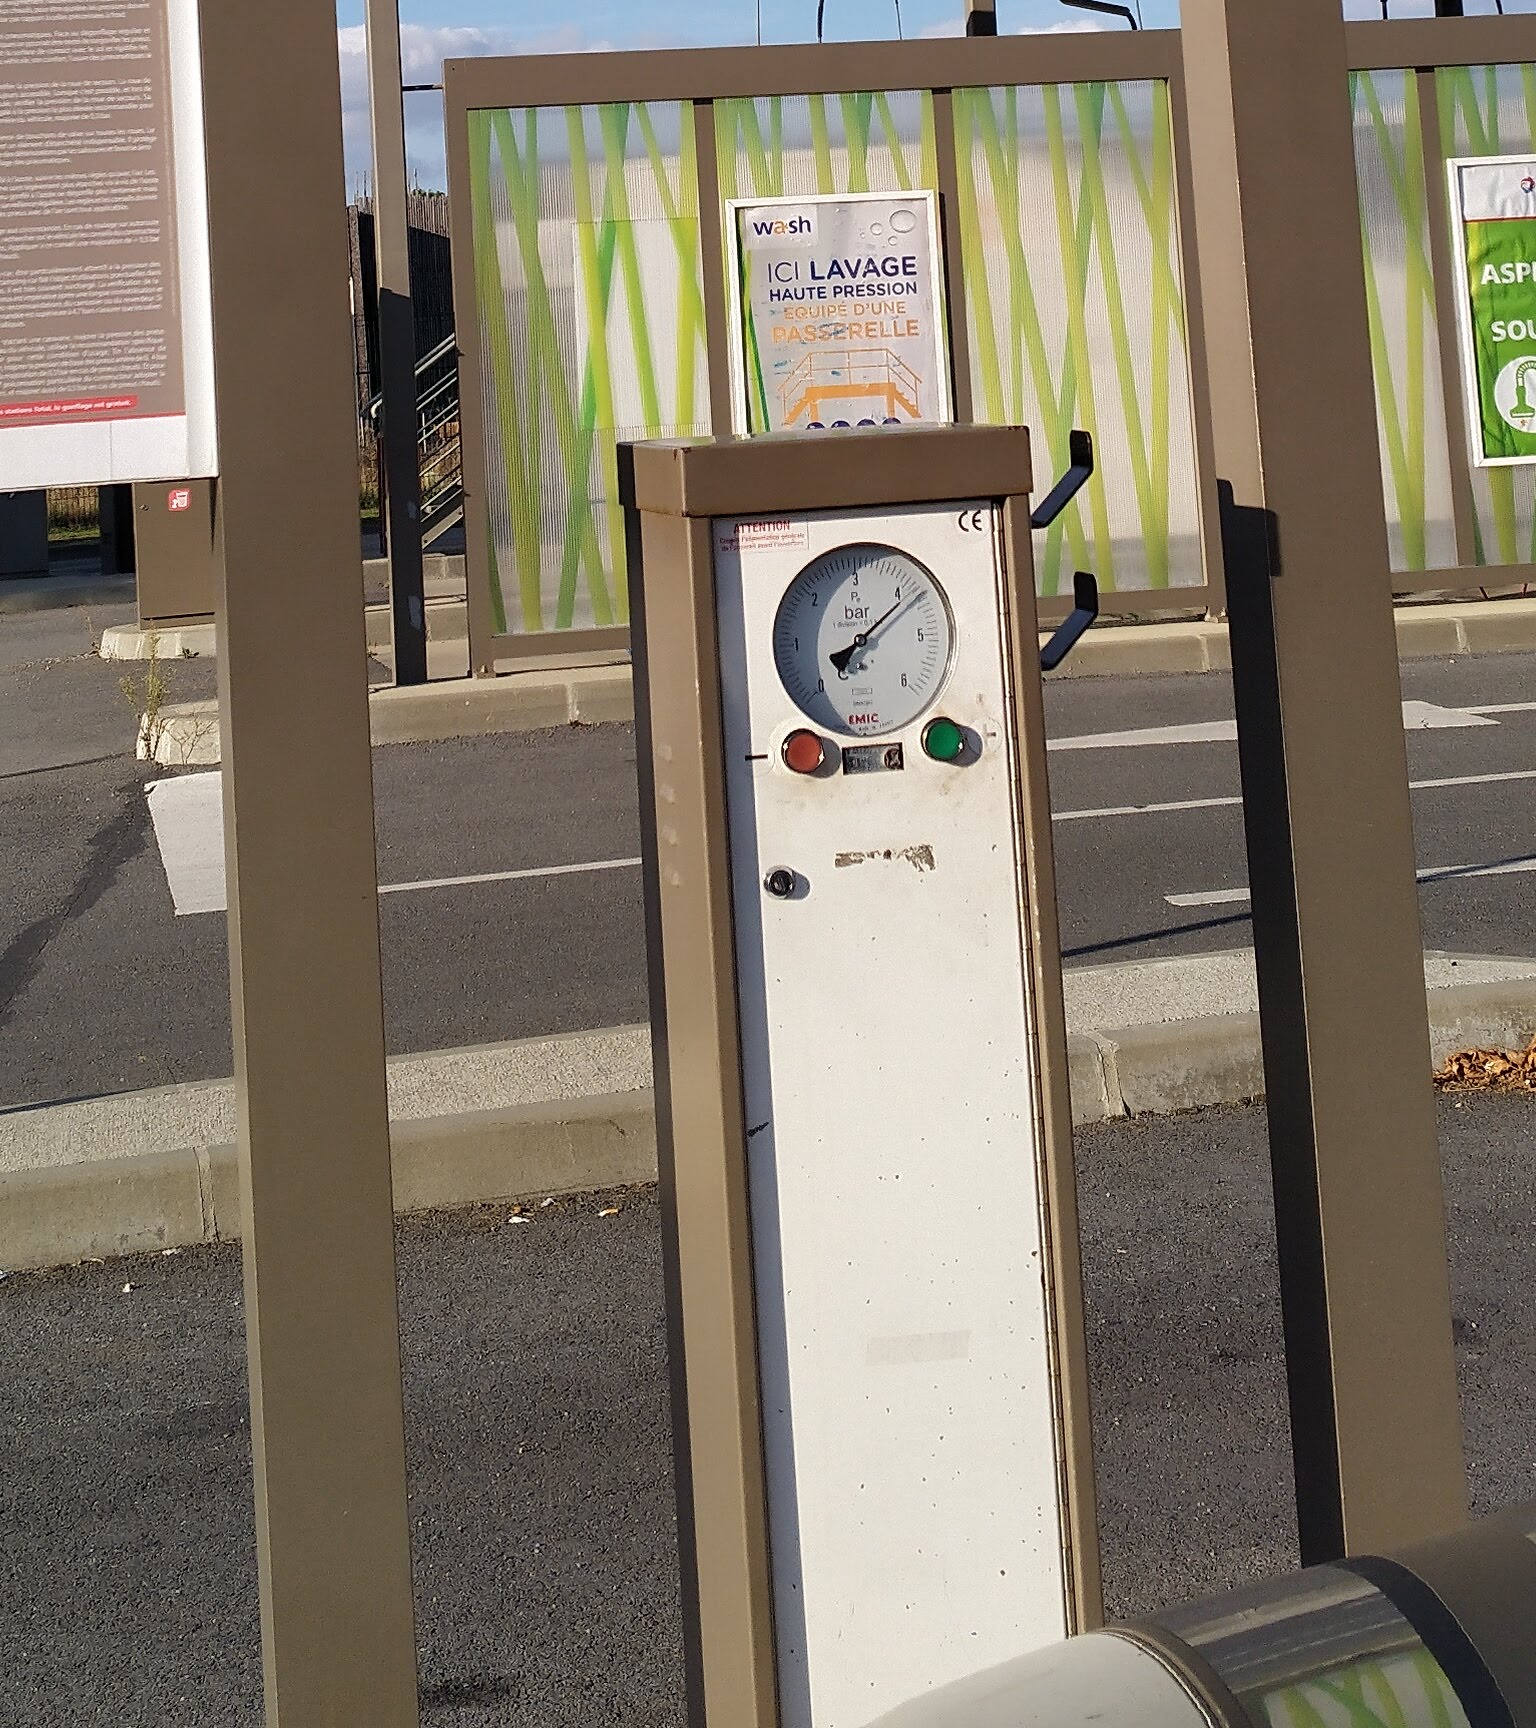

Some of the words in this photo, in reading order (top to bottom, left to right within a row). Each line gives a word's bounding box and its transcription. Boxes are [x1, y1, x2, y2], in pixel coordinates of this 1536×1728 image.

[752, 215, 812, 236] wash
[767, 261, 800, 283] ICI
[810, 256, 918, 281] LAVAGE
[769, 286, 827, 302] HAUTE
[832, 282, 918, 299] PRESSION
[853, 300, 906, 318] D'UNE
[771, 319, 920, 344] PASSERELLE
[733, 519, 791, 535] ATTENTION
[958, 509, 982, 532] CE
[852, 572, 859, 586] 3
[811, 593, 818, 607] 2
[894, 586, 901, 600] 4
[844, 605, 870, 620] bar
[917, 628, 924, 642] 5
[793, 637, 799, 652] 1
[817, 678, 824, 692] 0
[900, 673, 907, 687] 6
[848, 712, 879, 725] EMIC
